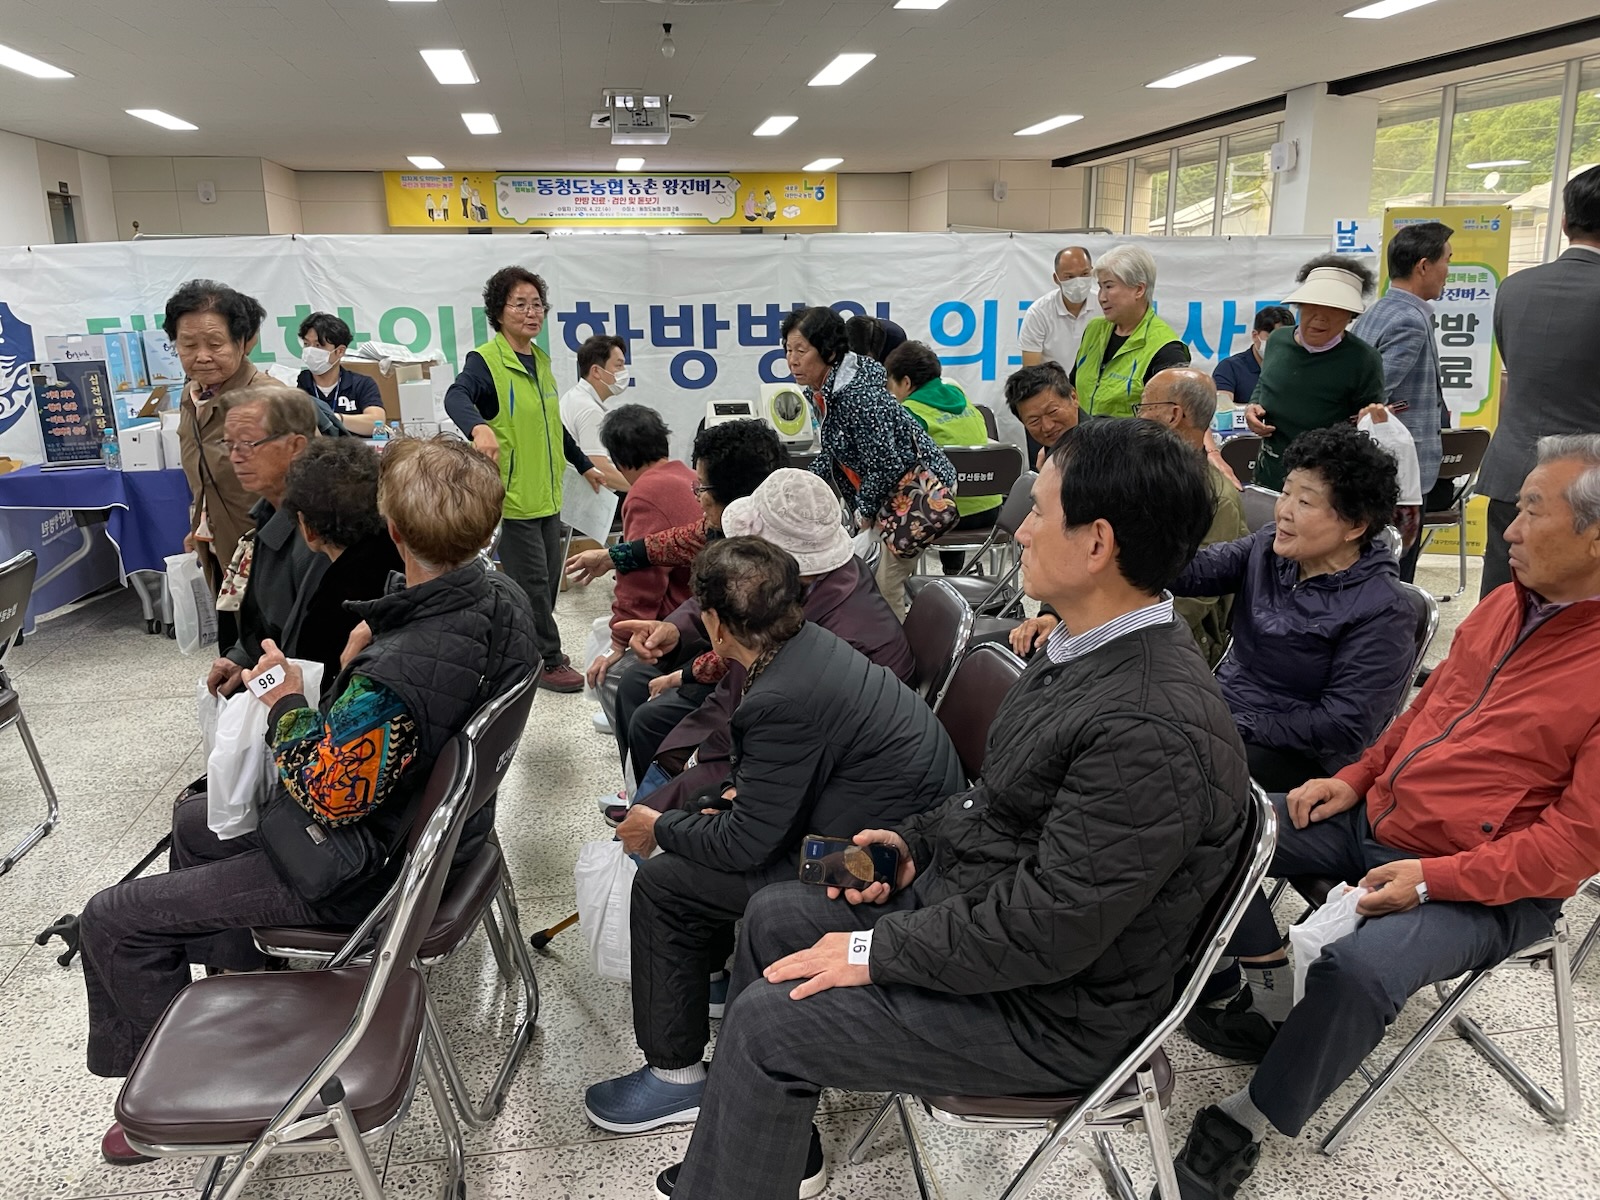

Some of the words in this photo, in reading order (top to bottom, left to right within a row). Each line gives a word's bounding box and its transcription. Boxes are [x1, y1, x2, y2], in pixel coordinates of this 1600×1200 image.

[537, 178, 623, 195] 동청도농협
[627, 178, 658, 195] 농촌
[662, 178, 727, 195] 왕진버스
[574, 197, 589, 205] 한방
[591, 197, 606, 205] 진료
[628, 197, 636, 205] 및
[637, 197, 660, 205] 돋보기
[1337, 220, 1358, 247] 남
[1430, 313, 1480, 347] 방
[1440, 356, 1473, 388] 료
[88, 374, 107, 429] 십전대보탕
[338, 396, 357, 411] DH
[1441, 454, 1463, 464] 동농협
[258, 673, 276, 689] 98
[853, 937, 867, 953] 97
